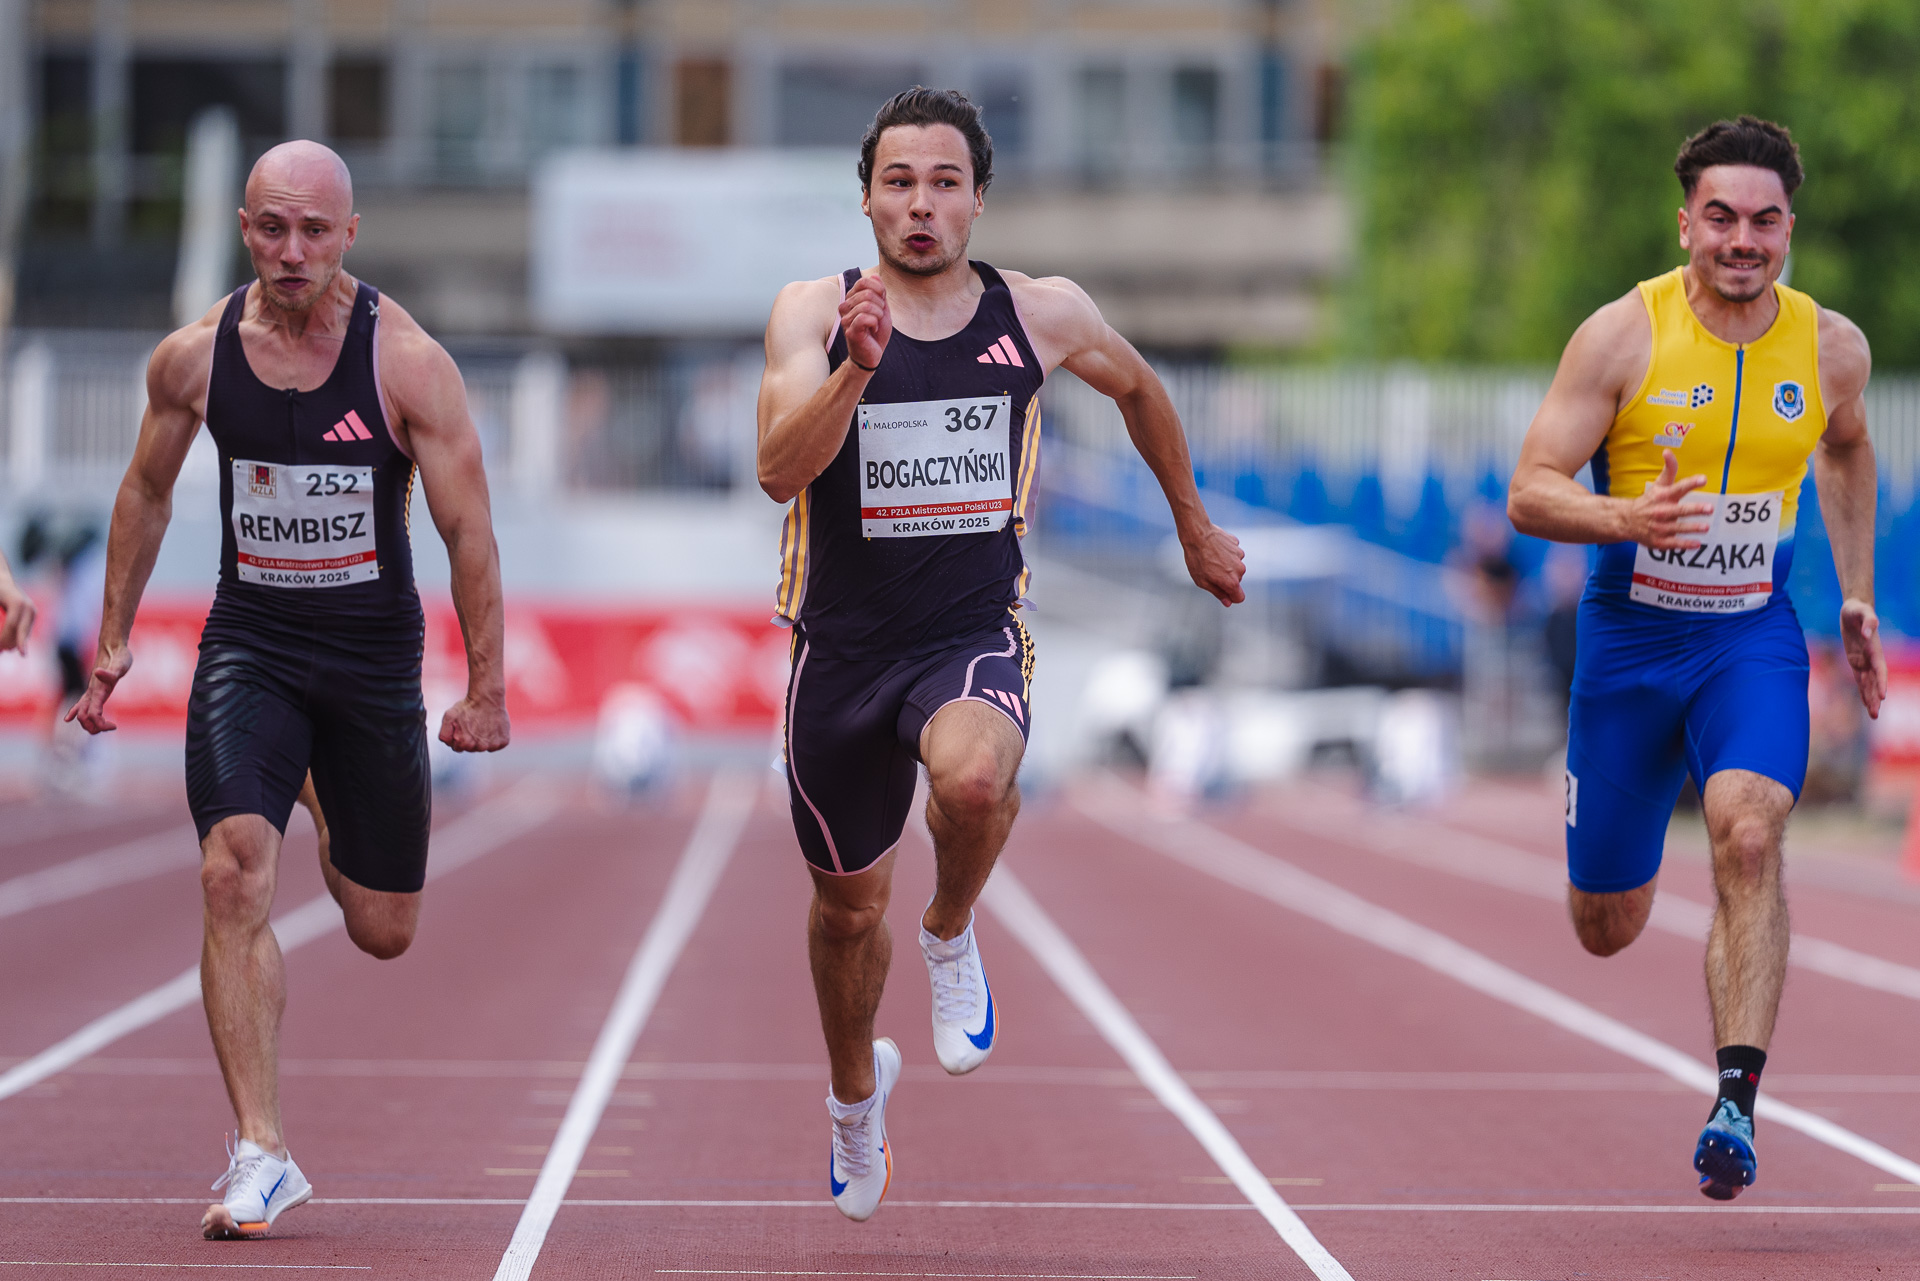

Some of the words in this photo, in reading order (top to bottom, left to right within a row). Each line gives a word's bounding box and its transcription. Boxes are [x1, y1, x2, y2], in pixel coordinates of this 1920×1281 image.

[873, 419, 928, 430] MAŁOPOLSKA
[944, 405, 998, 433] 367
[866, 448, 1005, 490] BOGACZYŃSKI
[250, 485, 274, 497] MZLA
[306, 472, 360, 497] 252
[876, 509, 889, 517] 42.
[891, 508, 911, 517] PZLA
[912, 504, 963, 515] Mistrzostwa
[965, 501, 988, 512] Polski
[989, 501, 1002, 510] U23
[1725, 499, 1771, 524] 356
[240, 511, 367, 544] REMBISZ
[893, 518, 955, 533] KRAKÓW
[958, 516, 990, 529] 2025
[258, 558, 274, 567] PZLA
[276, 560, 322, 569] Mistrzostwa
[324, 557, 348, 567] Polski
[349, 554, 364, 565] U23
[260, 572, 316, 584] KRAKÓW
[319, 570, 350, 583] 2025
[1657, 594, 1715, 608] KRAKÓW
